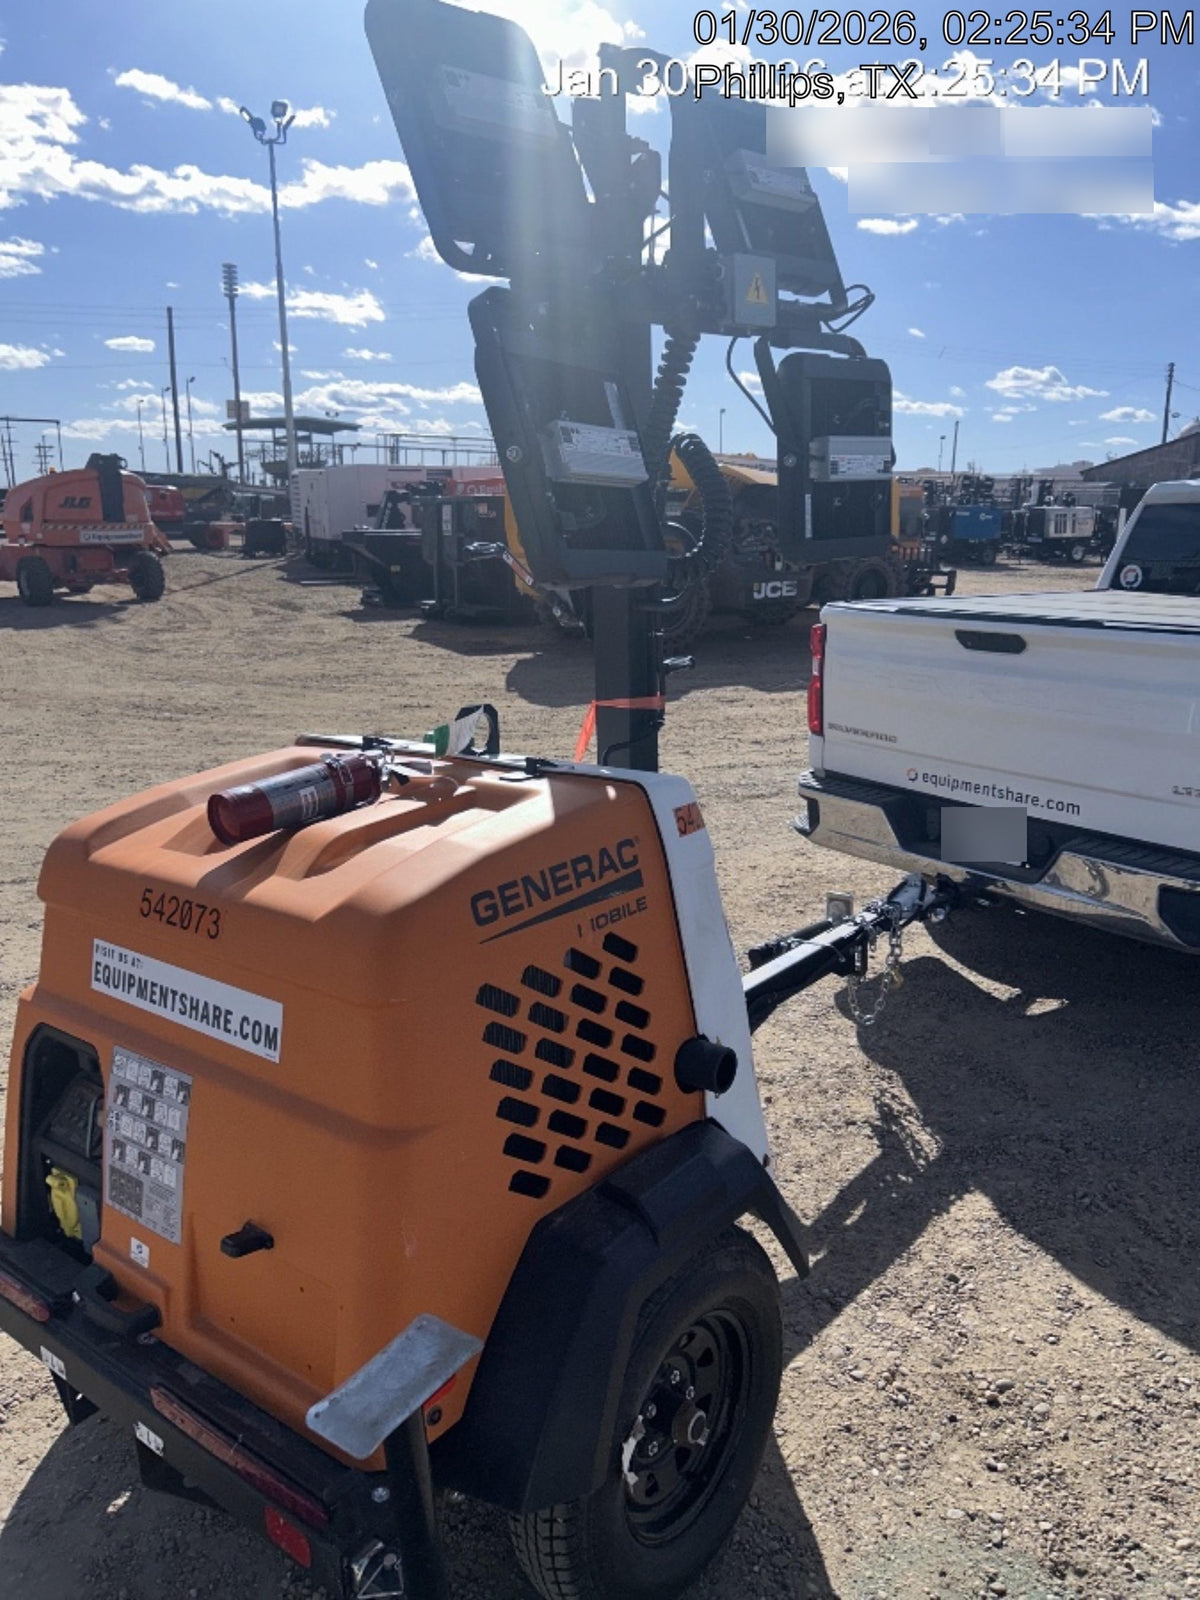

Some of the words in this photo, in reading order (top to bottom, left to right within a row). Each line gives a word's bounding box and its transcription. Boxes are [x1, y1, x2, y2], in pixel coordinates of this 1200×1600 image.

[922, 771, 1081, 816] equipmentshare.com
[470, 838, 639, 927] GENERAC
[139, 888, 221, 939] 542073
[95, 943, 115, 960] VISIT
[94, 961, 278, 1052] EQUIPMENTSHARE.COM
